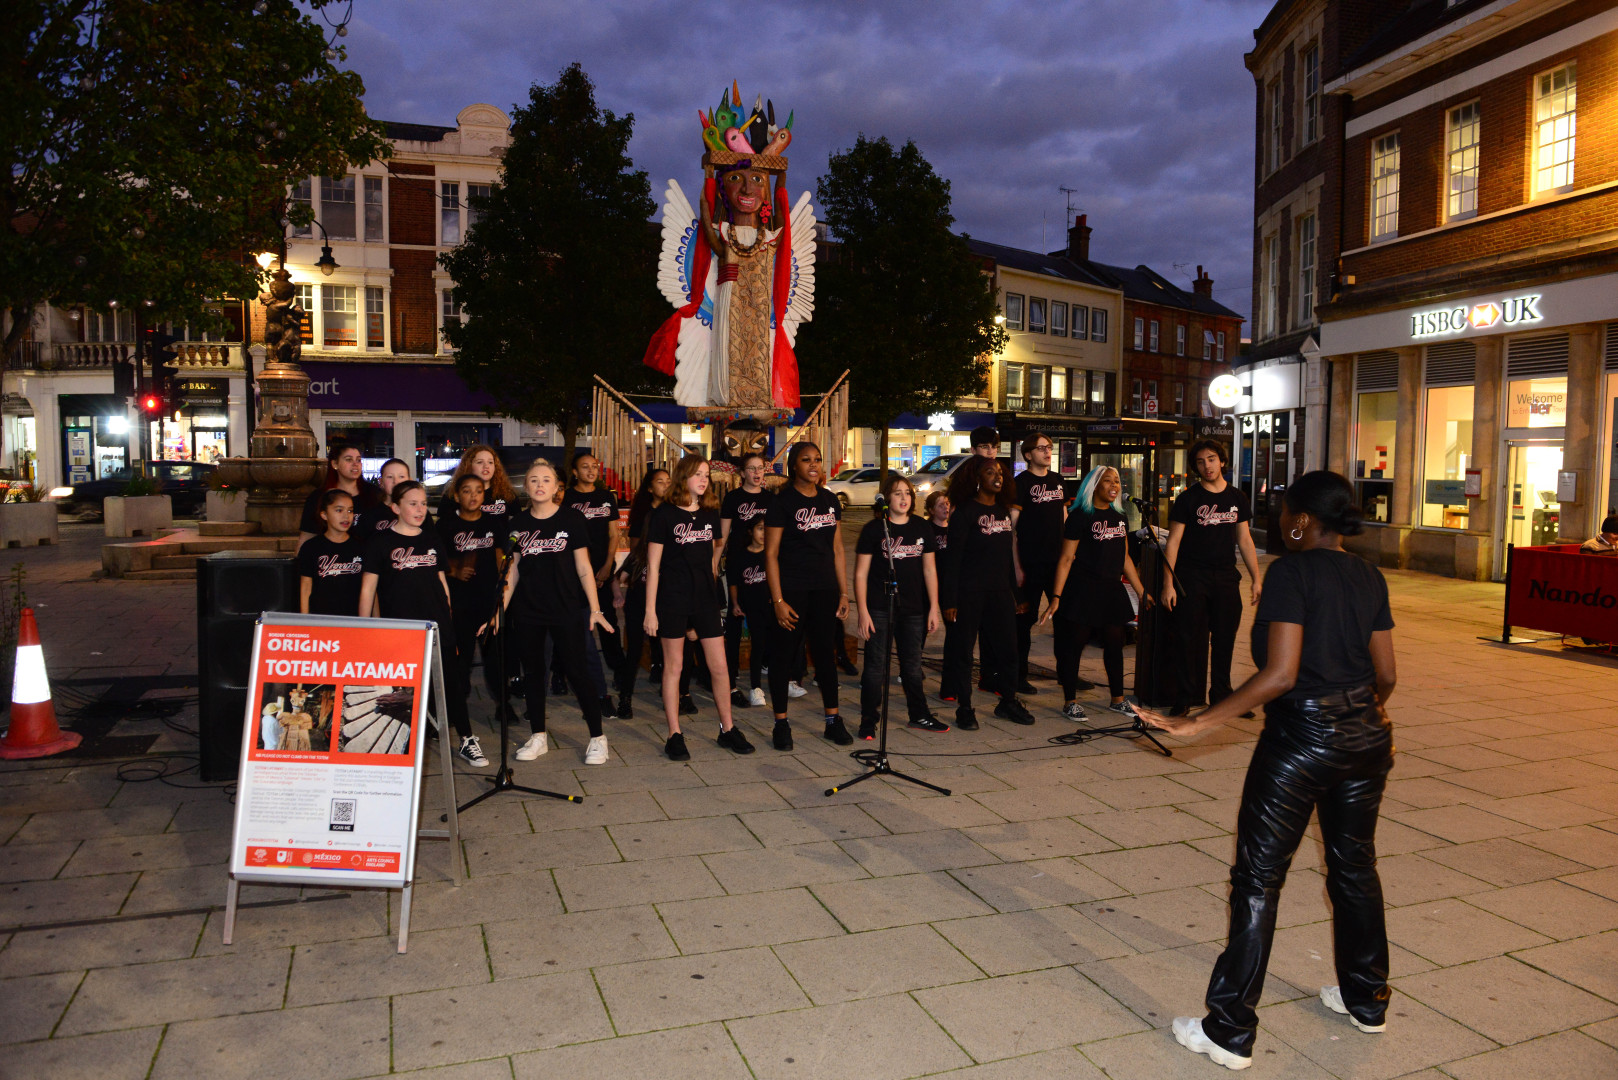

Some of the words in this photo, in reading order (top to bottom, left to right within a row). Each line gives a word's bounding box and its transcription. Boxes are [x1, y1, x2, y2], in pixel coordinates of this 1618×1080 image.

[1410, 307, 1466, 338] HSBC
[1501, 296, 1541, 324] UK
[1516, 393, 1563, 405] Welcome
[454, 531, 494, 551] Young
[519, 530, 568, 556] Young
[673, 522, 714, 544] Young
[318, 554, 362, 577] Young
[391, 547, 437, 570] Young
[267, 638, 341, 653] ORIGINS
[265, 659, 328, 678] TOTEM
[332, 661, 418, 680] LATAMAT
[313, 852, 342, 861] MÉXICO
